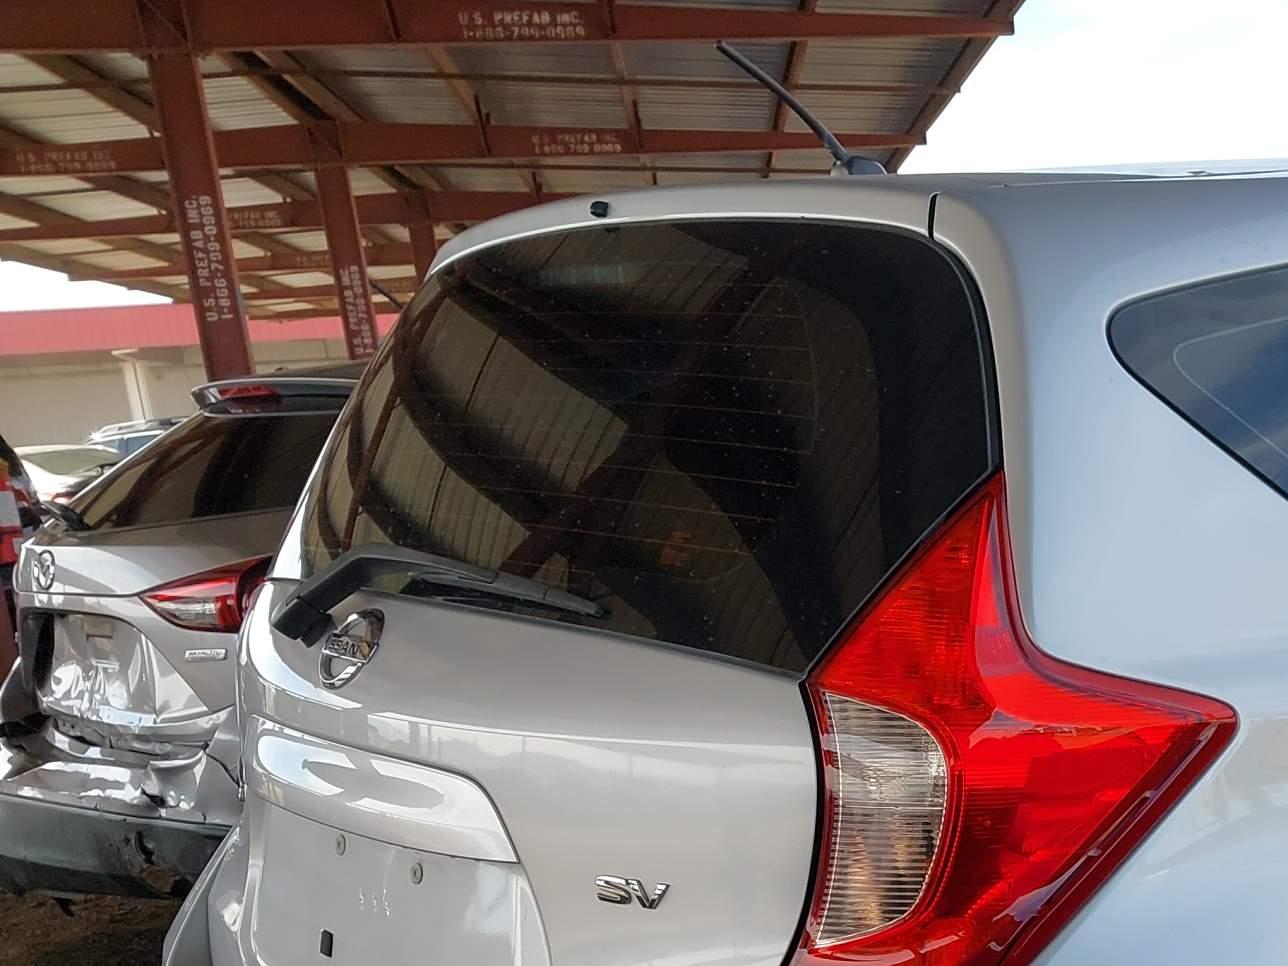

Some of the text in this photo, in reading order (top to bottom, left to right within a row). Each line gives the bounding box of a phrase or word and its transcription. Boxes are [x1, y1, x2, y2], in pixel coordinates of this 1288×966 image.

[184, 195, 219, 321] U.S. PREFAB INC.
[199, 195, 234, 320] 1-866-799-0969
[595, 874, 671, 910] SV
